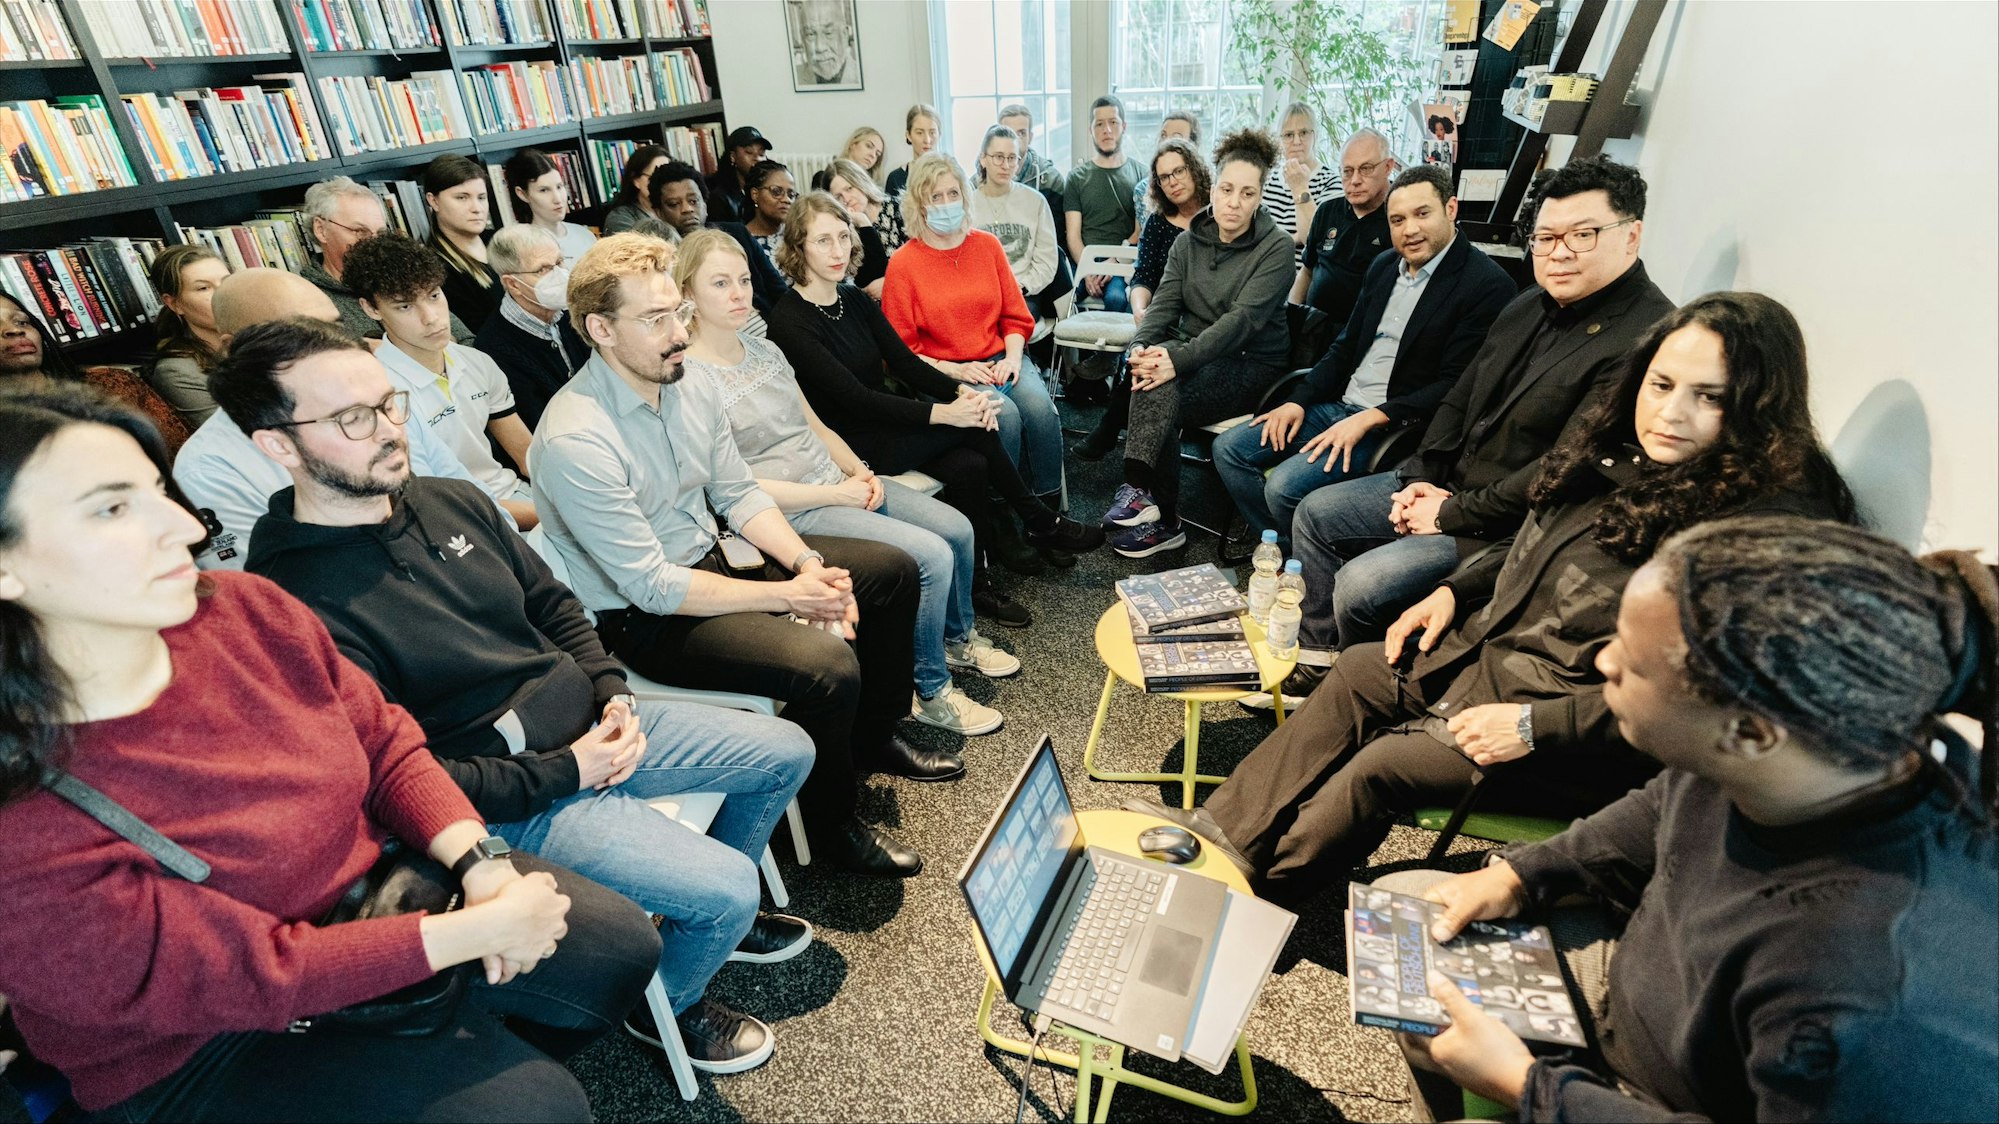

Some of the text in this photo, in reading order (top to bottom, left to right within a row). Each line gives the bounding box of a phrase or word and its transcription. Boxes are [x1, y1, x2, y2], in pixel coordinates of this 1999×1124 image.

[21, 259, 40, 284] ROSE
[68, 256, 80, 273] BAD
[76, 270, 93, 296] WITCH
[33, 281, 57, 318] CONCRETE
[1400, 953, 1413, 994] PEOPLE
